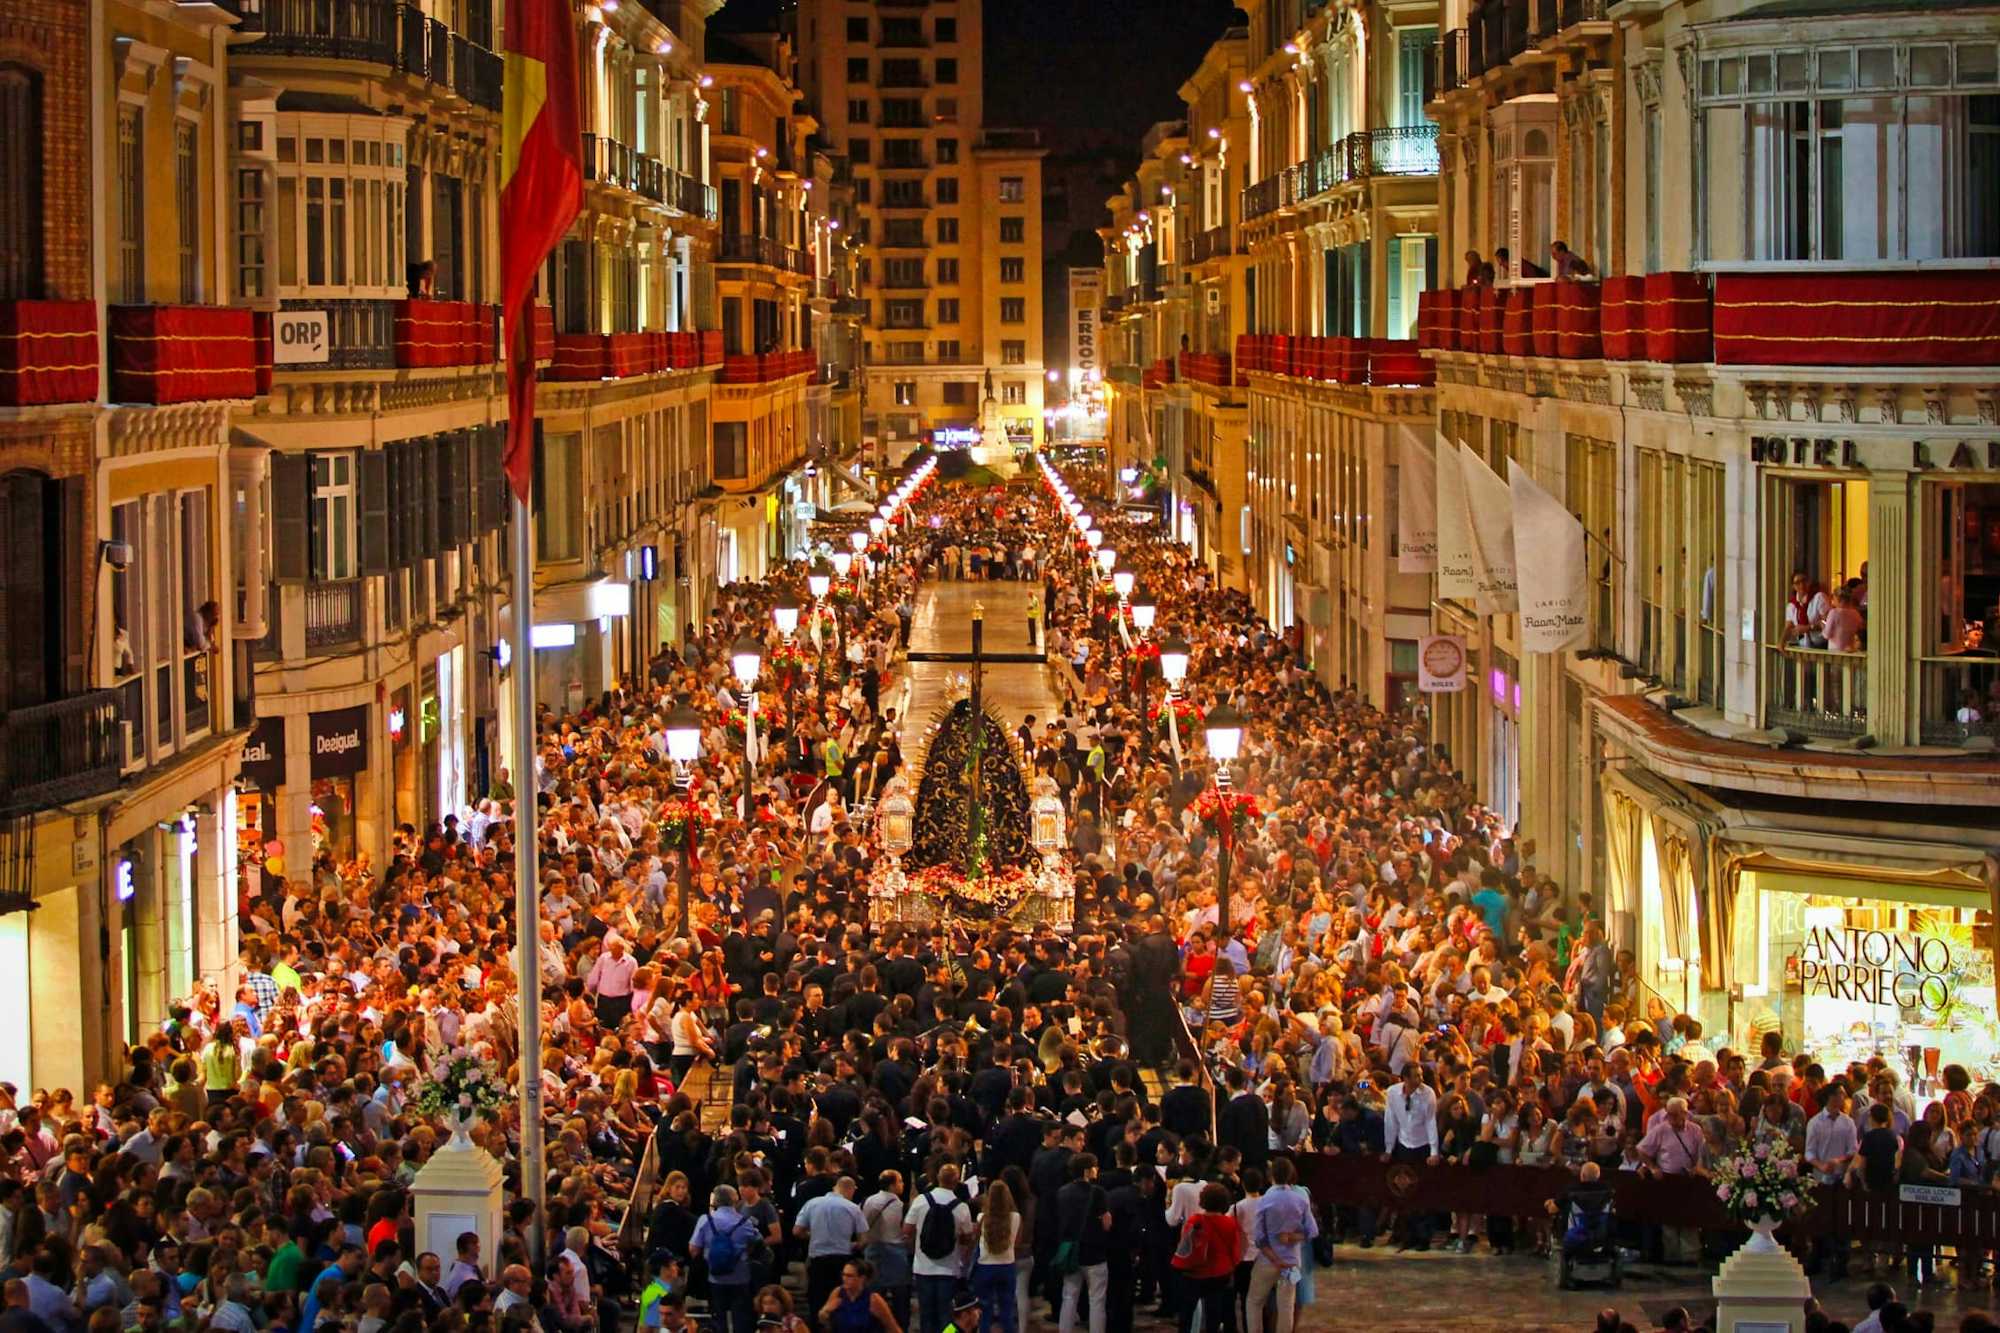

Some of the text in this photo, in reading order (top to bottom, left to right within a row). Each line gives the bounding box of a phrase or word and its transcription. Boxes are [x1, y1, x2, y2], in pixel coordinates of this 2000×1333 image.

[1751, 436, 1861, 468] HOTEL
[1535, 599, 1572, 608] LARIOS
[1801, 924, 1950, 974] ANTONIO
[1801, 960, 1948, 1011] PARRIEGO
